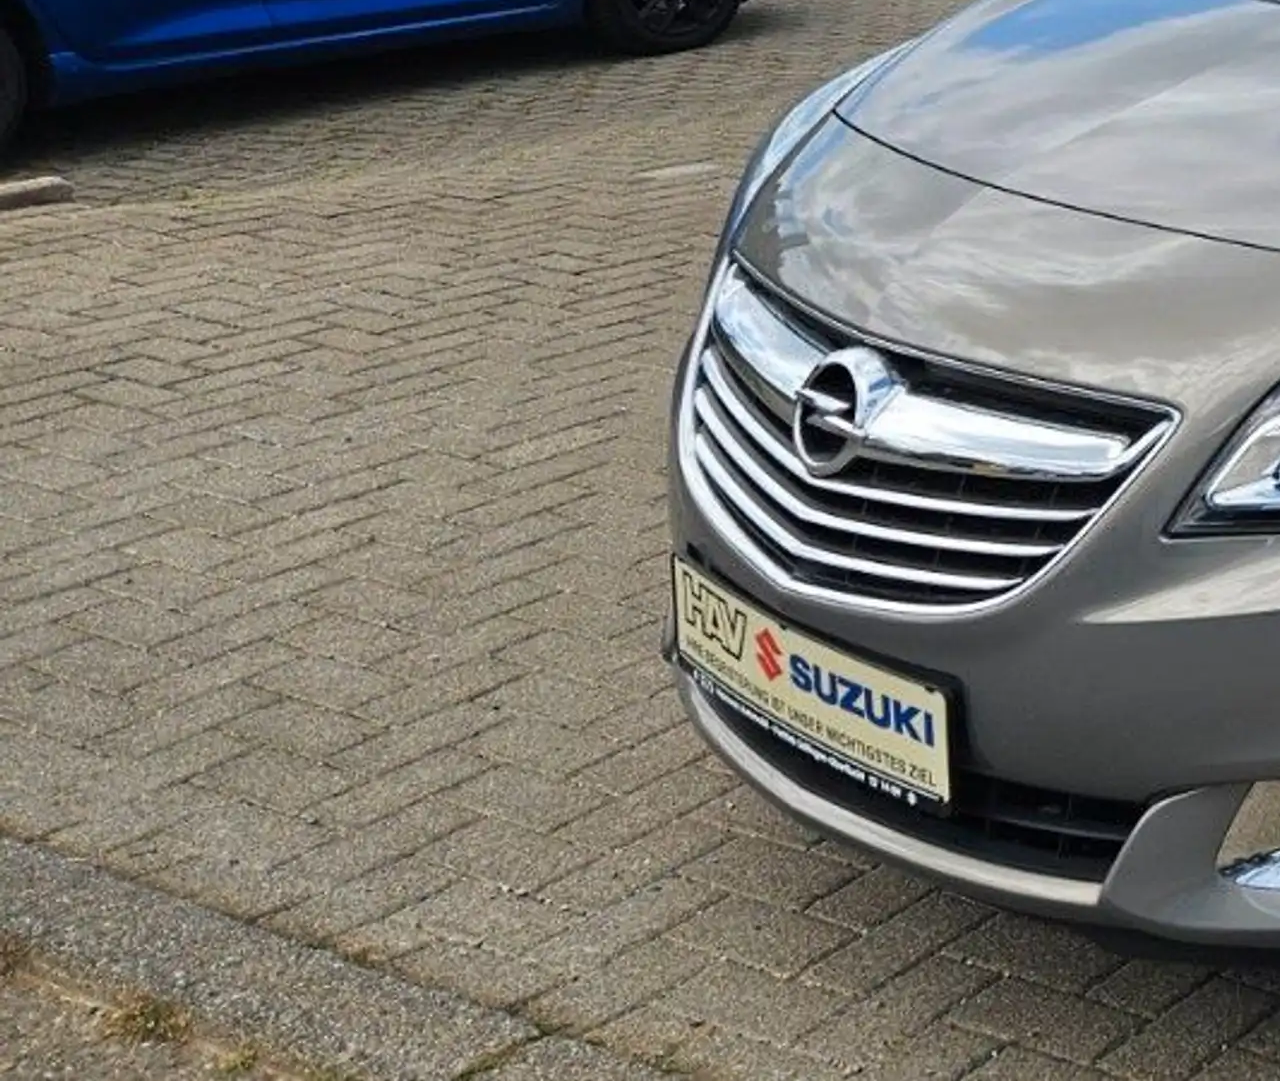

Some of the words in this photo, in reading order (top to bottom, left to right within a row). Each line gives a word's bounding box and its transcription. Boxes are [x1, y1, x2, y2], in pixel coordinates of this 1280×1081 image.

[683, 568, 748, 661] HAV
[789, 653, 935, 748] SUZUKI
[908, 761, 936, 788] ZIEL
